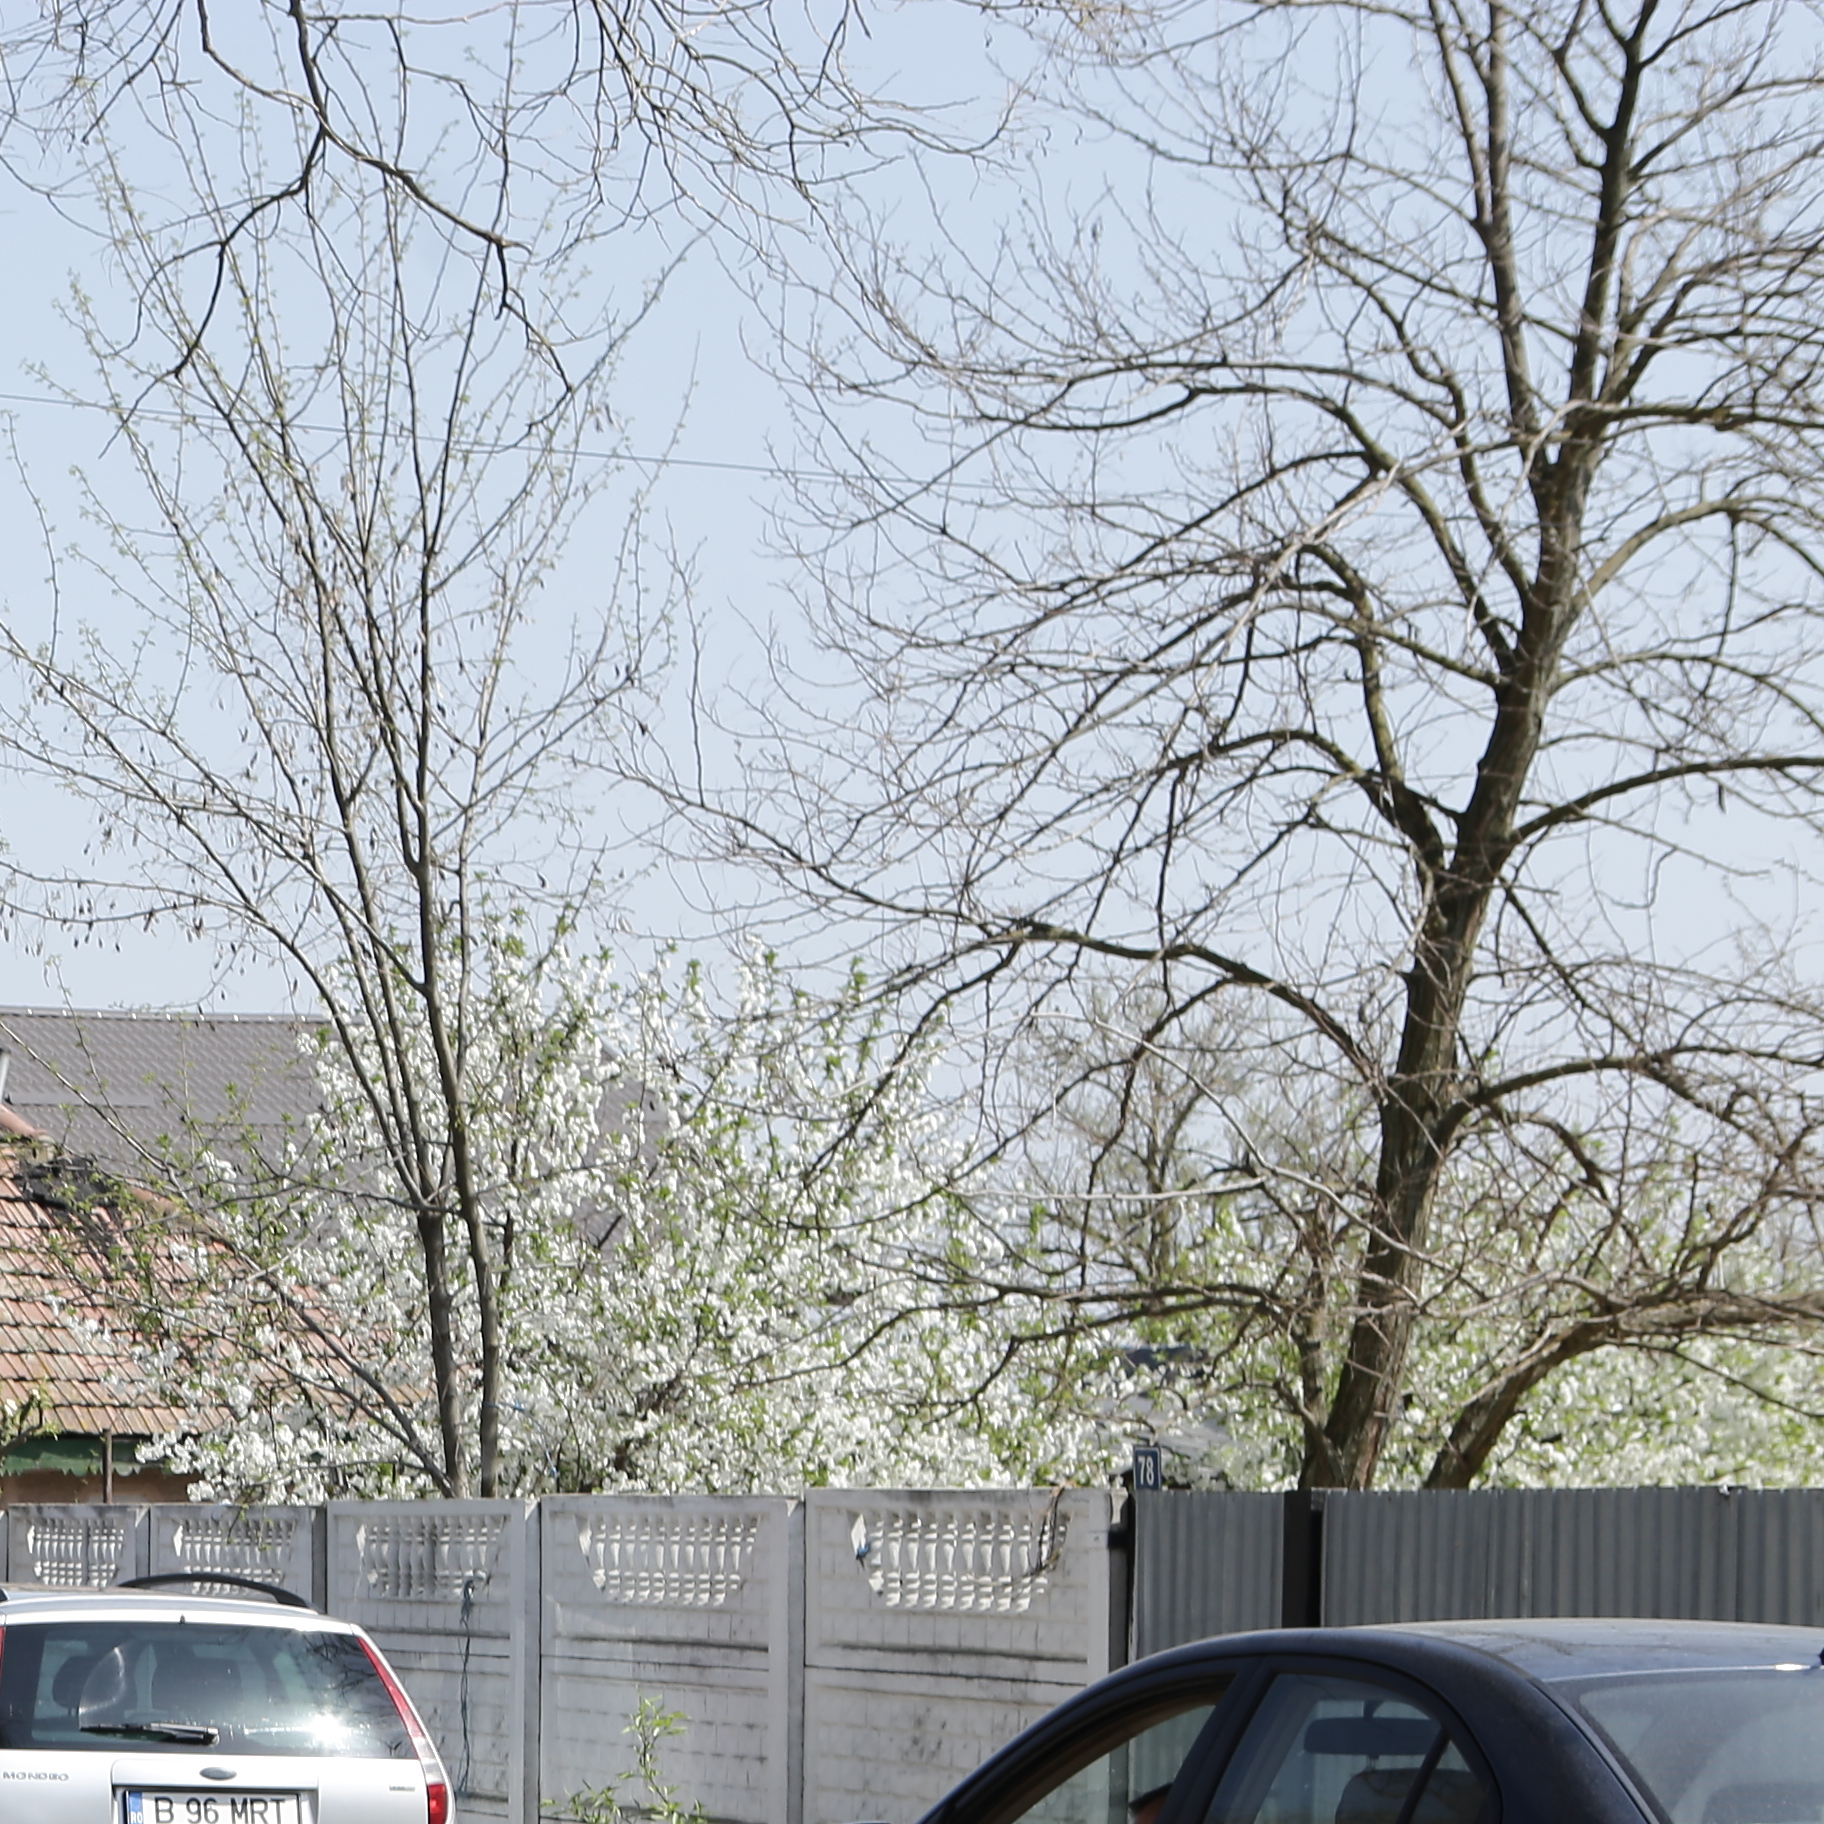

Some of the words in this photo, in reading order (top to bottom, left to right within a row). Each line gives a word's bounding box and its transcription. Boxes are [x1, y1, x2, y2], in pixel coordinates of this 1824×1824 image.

[130, 1811, 143, 1824] RO
[154, 1796, 174, 1824] B
[185, 1797, 220, 1824] 96
